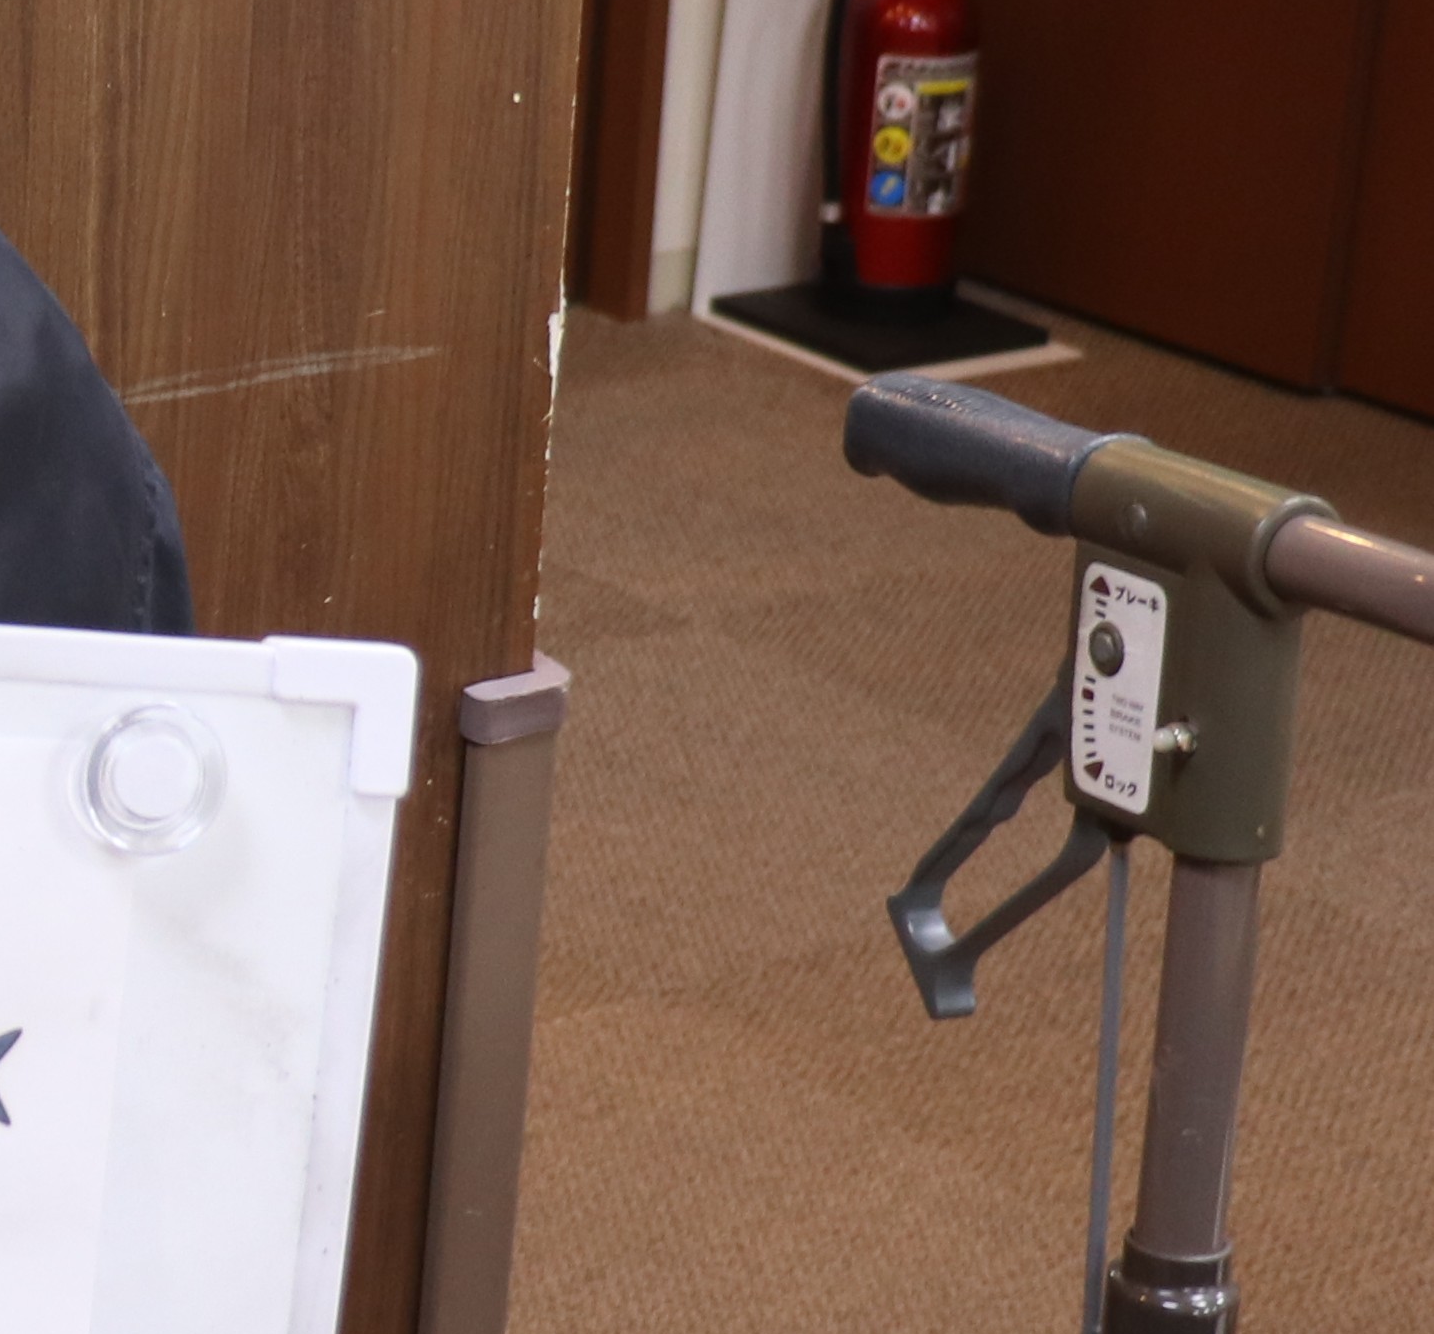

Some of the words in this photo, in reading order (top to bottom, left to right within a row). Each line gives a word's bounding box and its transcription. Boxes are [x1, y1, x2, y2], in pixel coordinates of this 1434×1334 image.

[1115, 585, 1159, 612] ブレーキ
[1105, 774, 1138, 798] ロック
